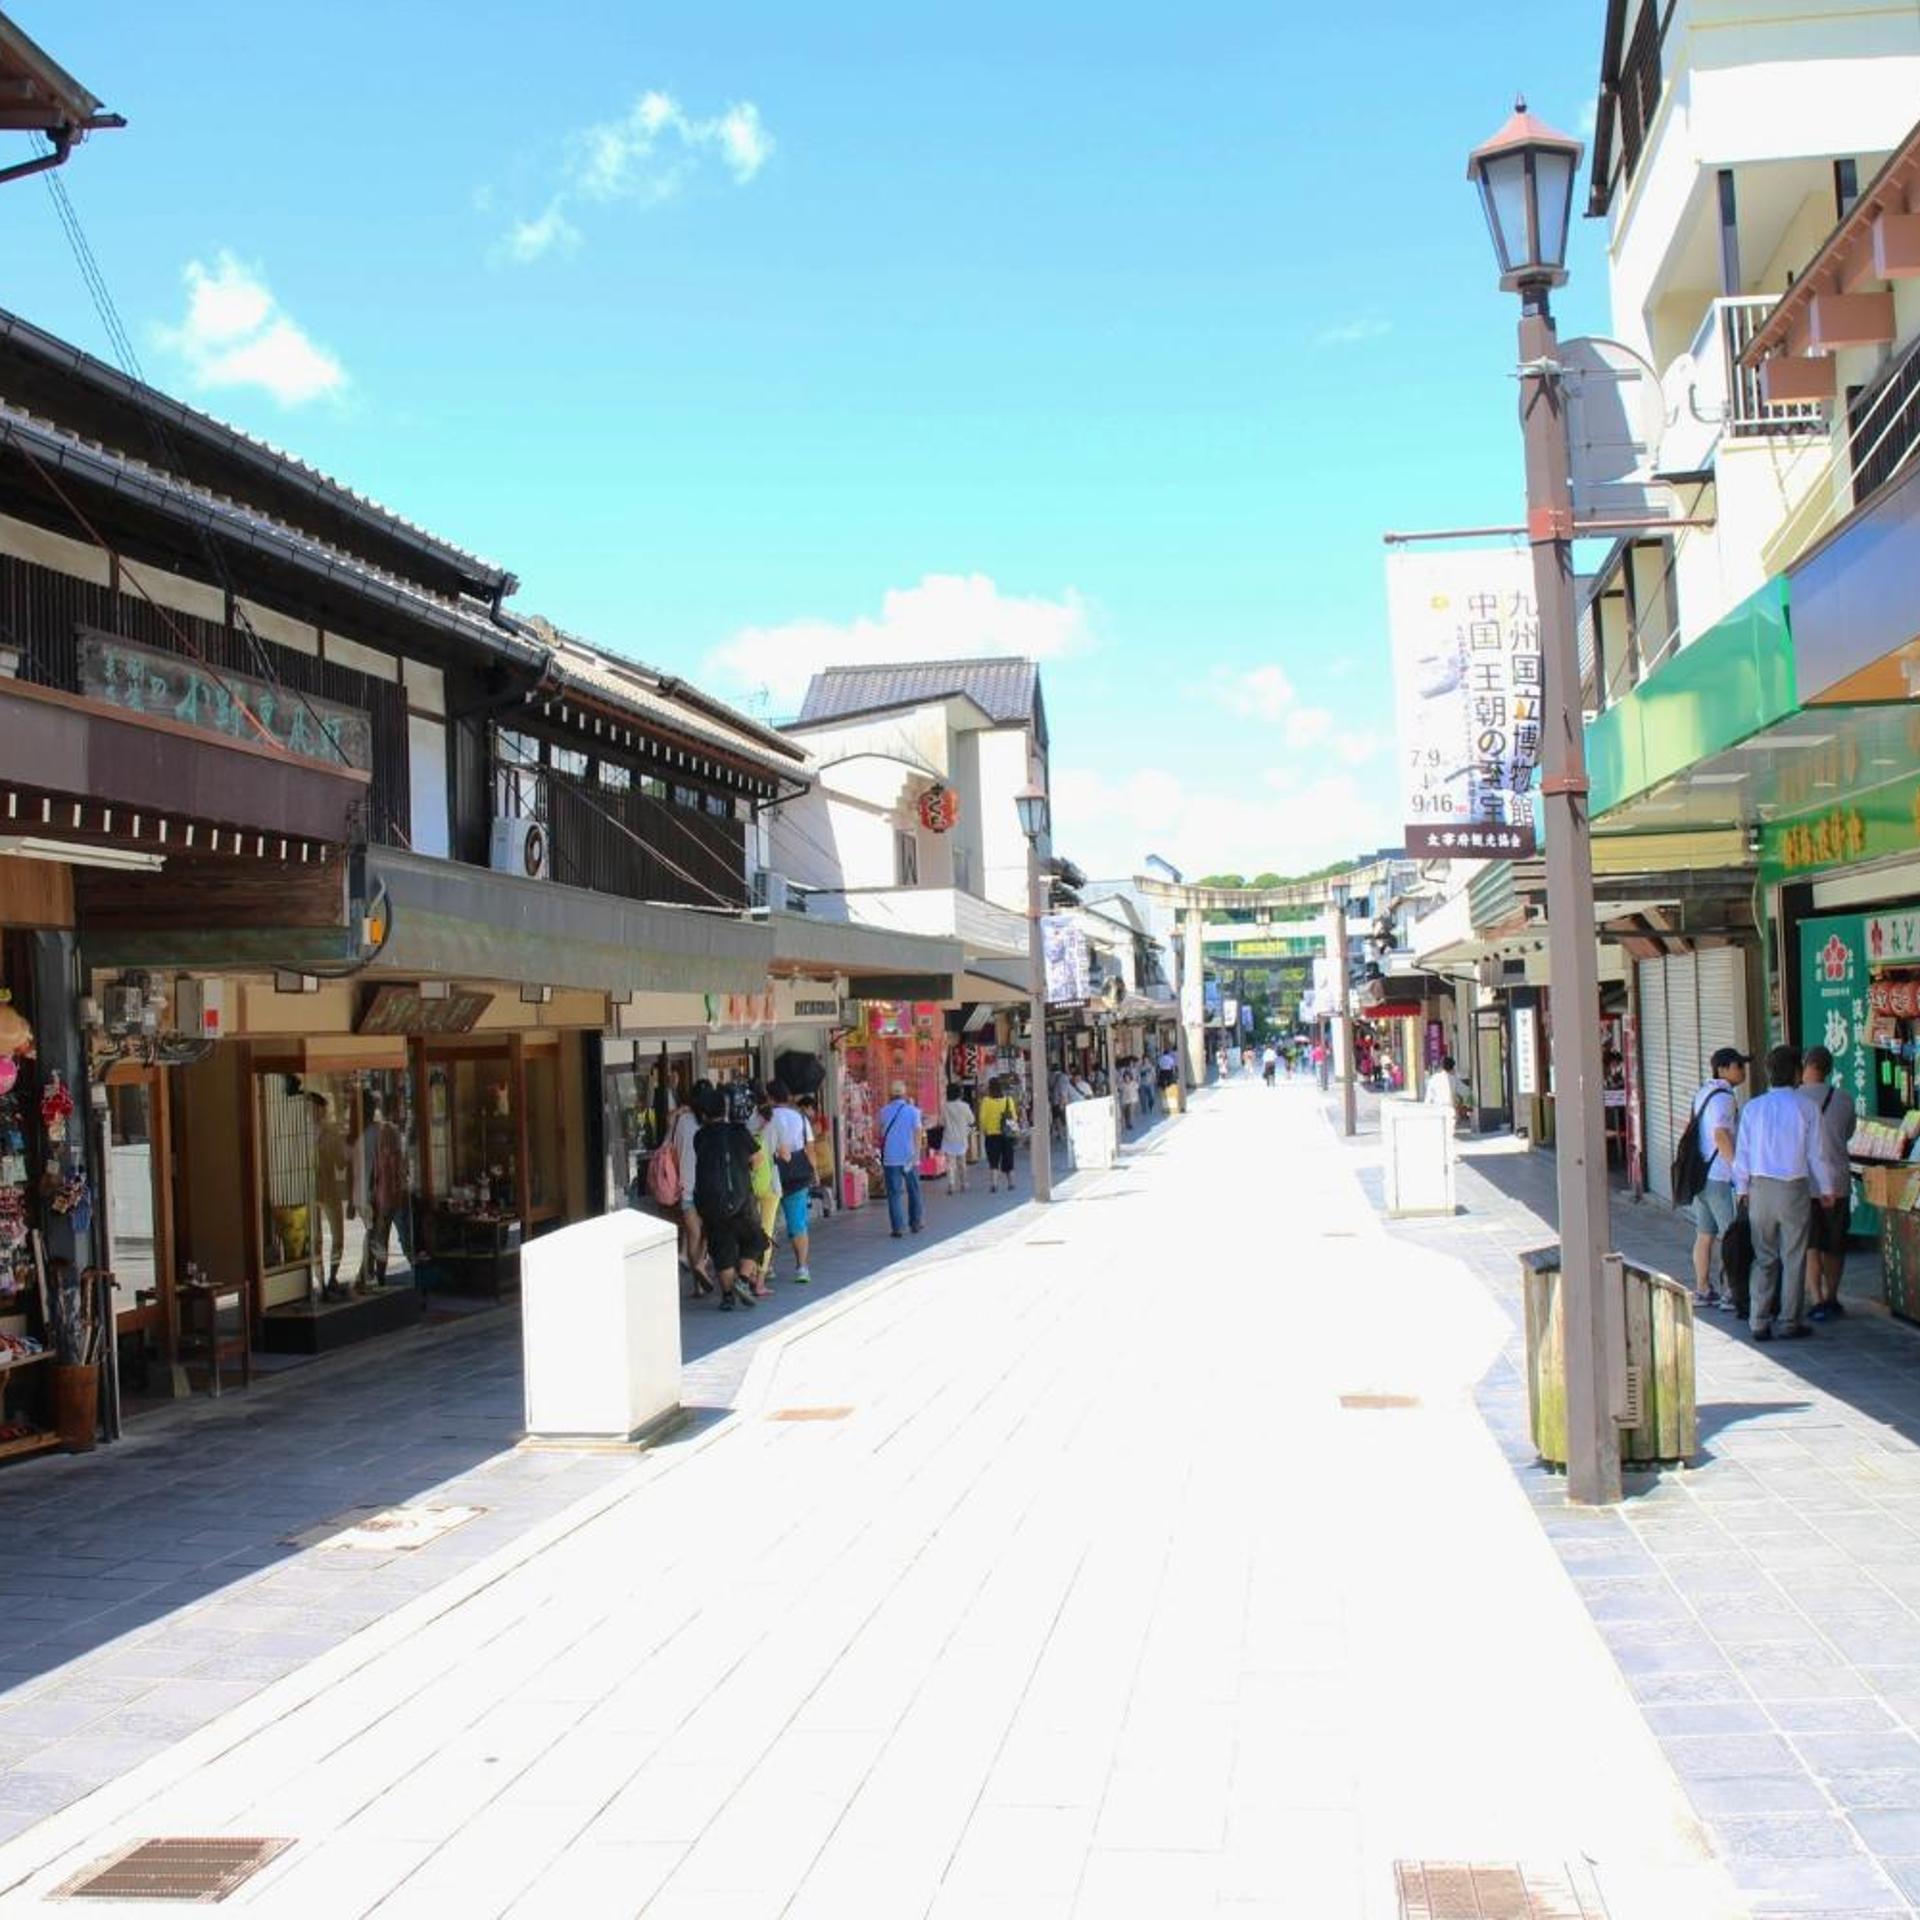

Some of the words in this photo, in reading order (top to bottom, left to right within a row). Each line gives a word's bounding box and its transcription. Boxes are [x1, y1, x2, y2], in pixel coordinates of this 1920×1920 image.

[1468, 592, 1506, 824] 中国王朝の至宝
[1509, 589, 1541, 827] 九州国立博物館
[1427, 832, 1521, 848] 太宰府観光協会
